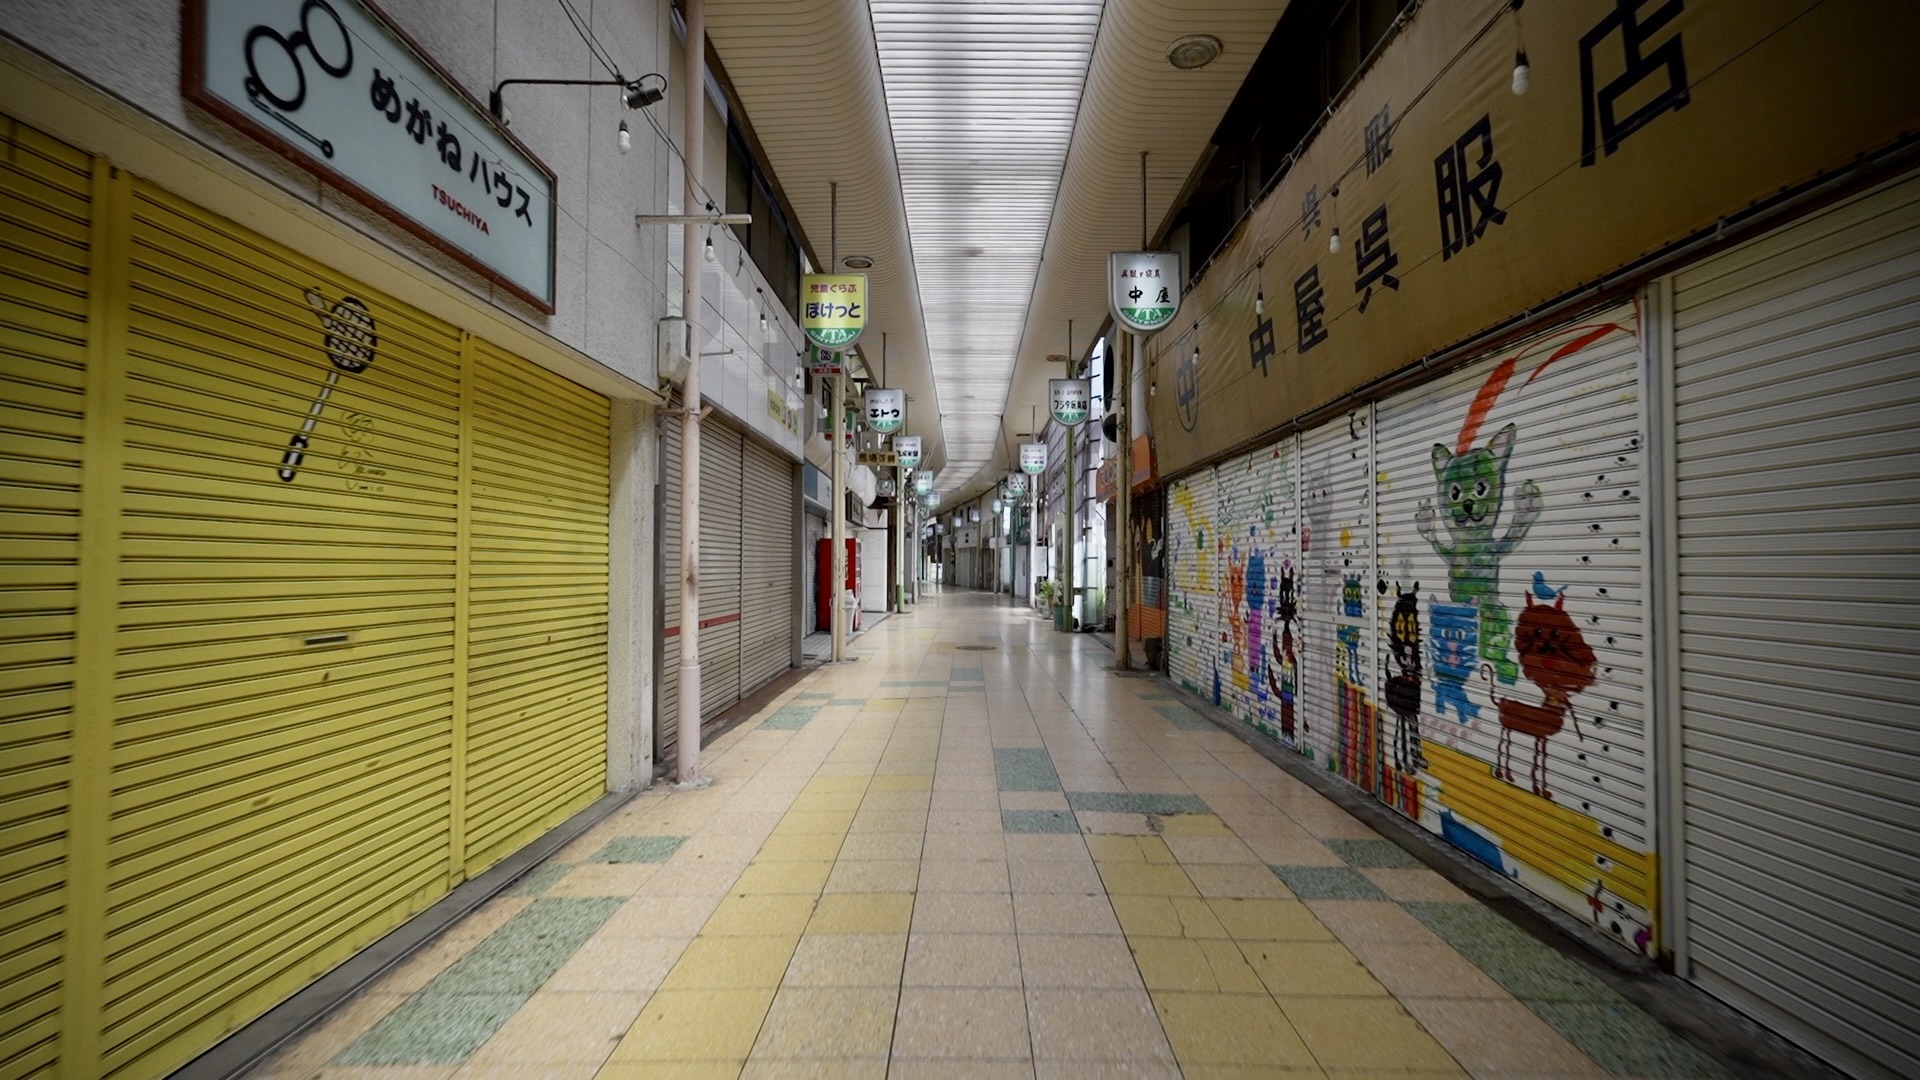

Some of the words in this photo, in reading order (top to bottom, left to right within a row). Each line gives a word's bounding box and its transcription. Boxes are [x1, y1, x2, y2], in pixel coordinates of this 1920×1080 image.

[371, 67, 534, 229] めがねハウス
[431, 183, 491, 236] TSUCHIYA
[810, 283, 858, 293] 児童くらぶ
[1134, 308, 1163, 320] ITA
[820, 329, 848, 339] ITA
[869, 408, 901, 419] エトウ
